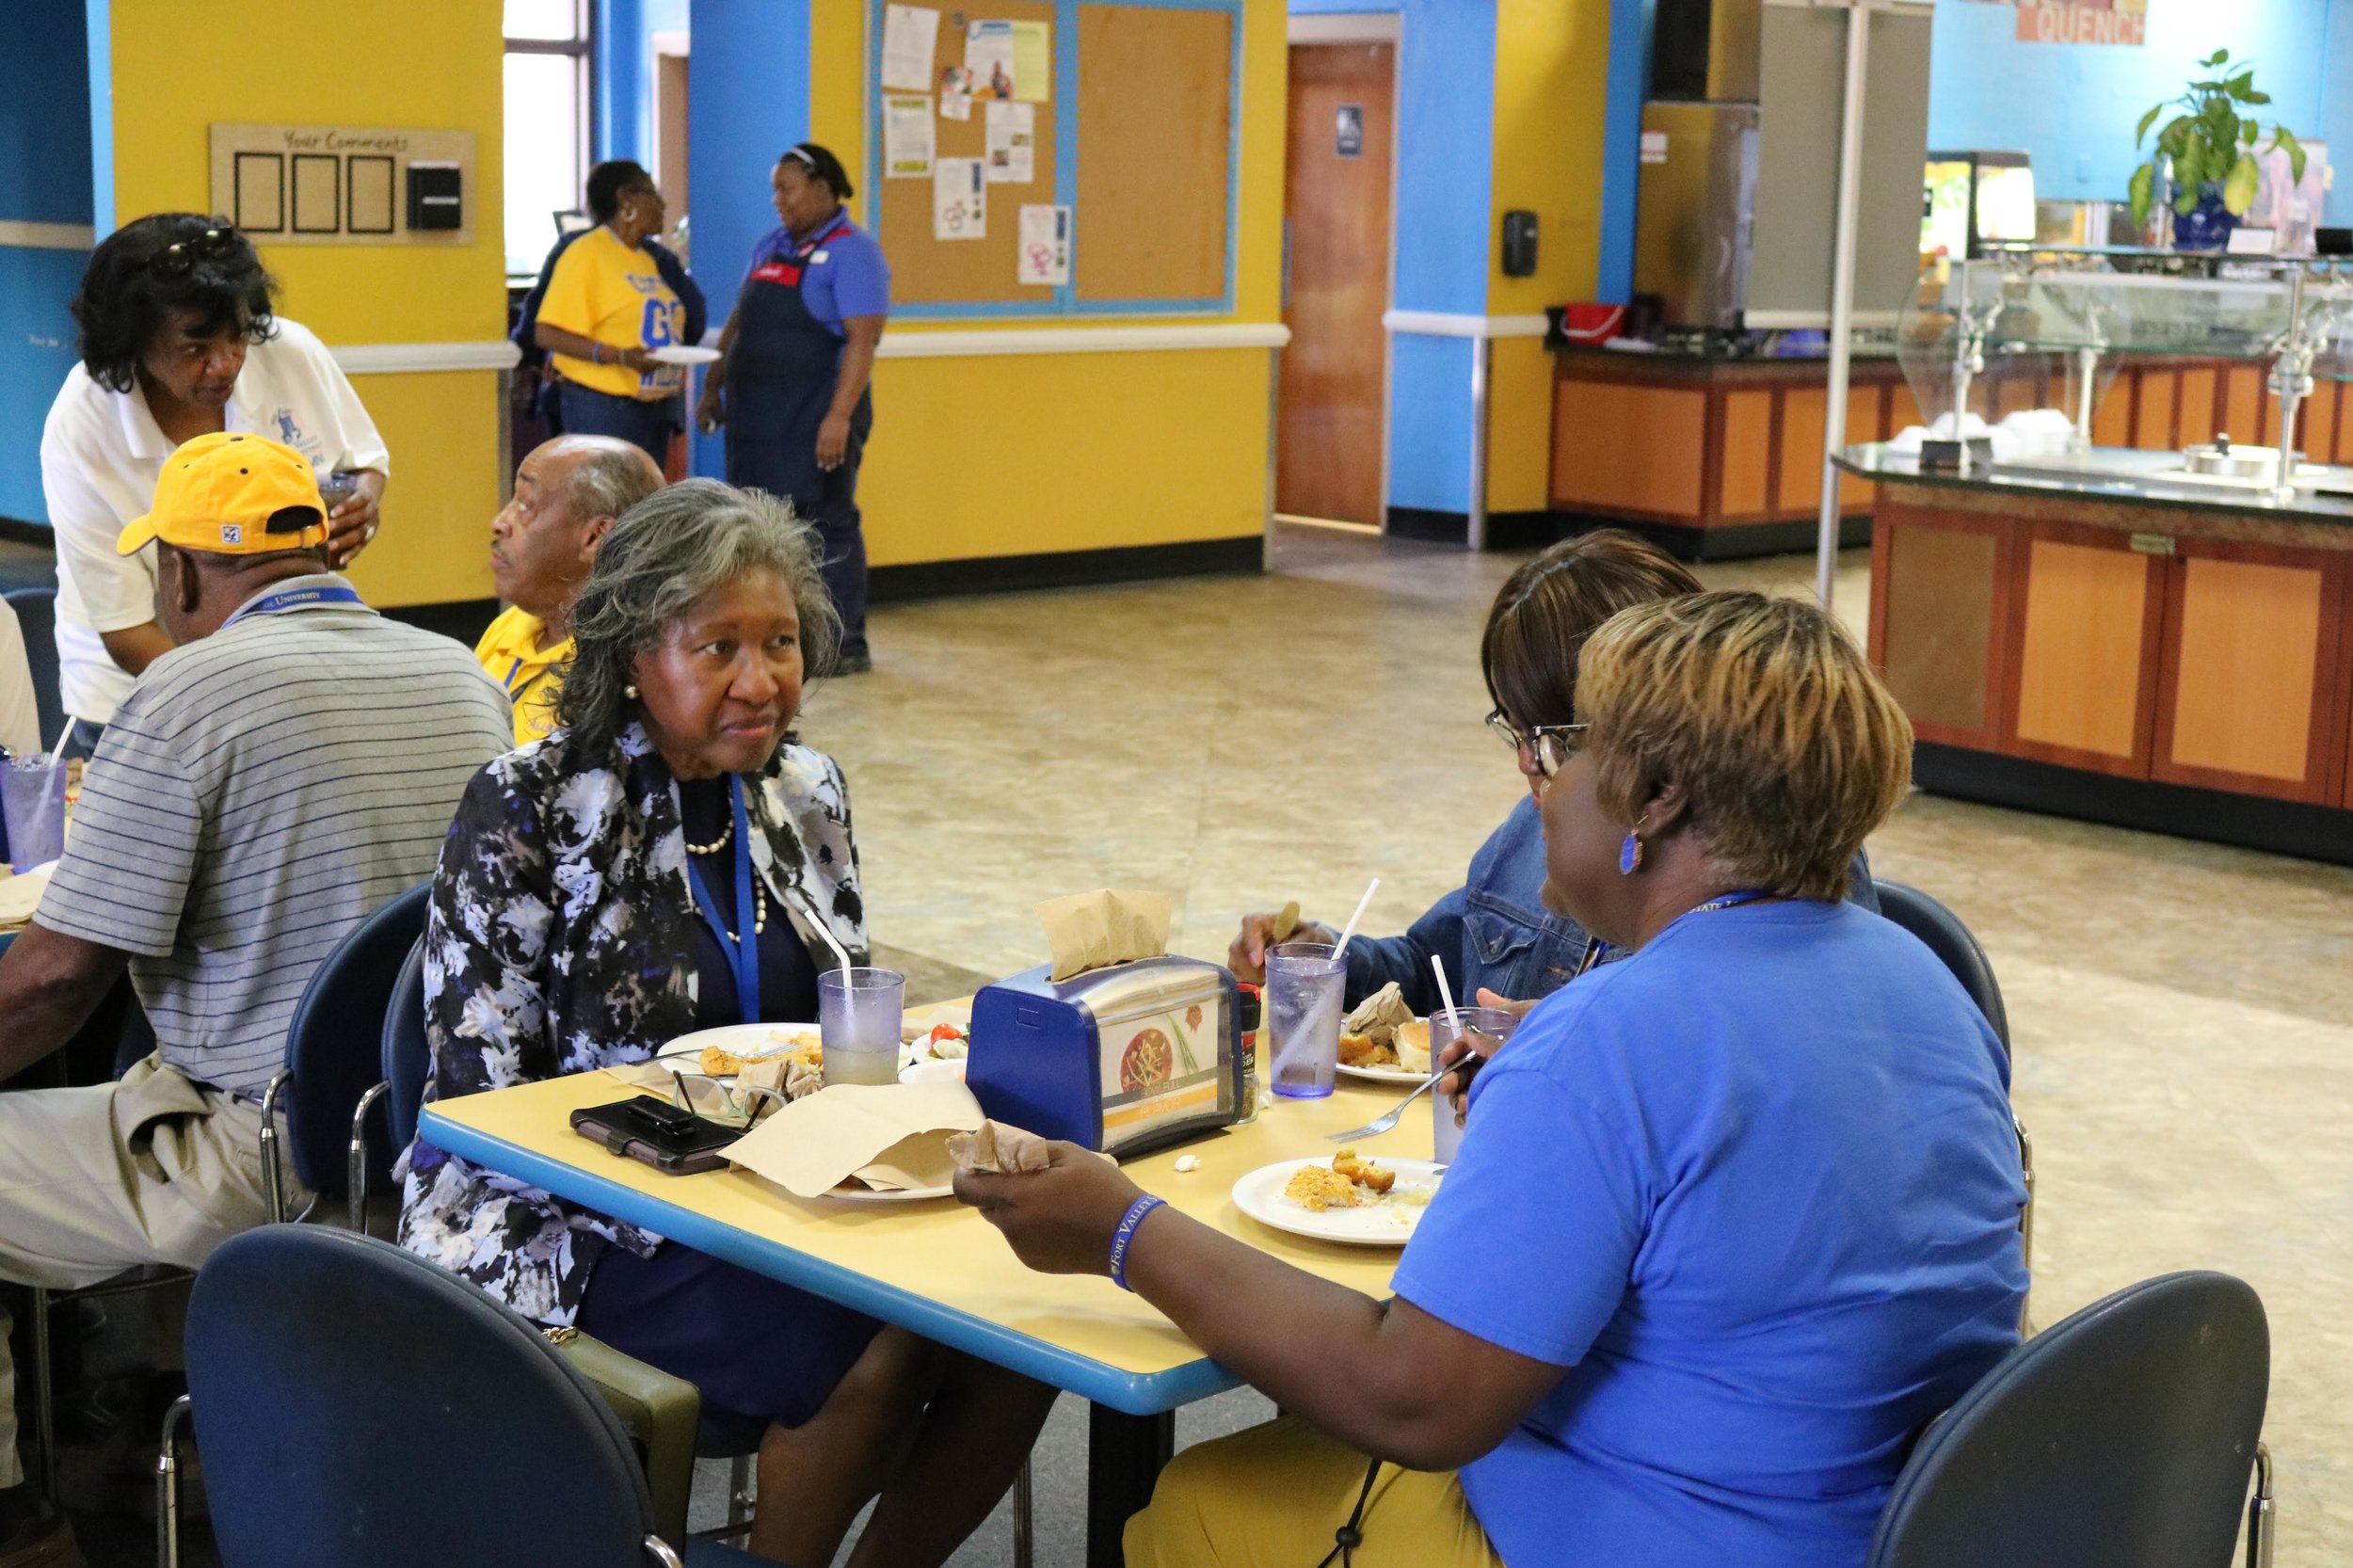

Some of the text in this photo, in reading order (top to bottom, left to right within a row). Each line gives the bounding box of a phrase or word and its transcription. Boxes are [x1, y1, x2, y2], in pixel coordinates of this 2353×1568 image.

[2037, 8, 2145, 44] QUENCH
[283, 129, 408, 152] Your Comments
[274, 591, 321, 606] UNIVERSITY
[1111, 1199, 1152, 1267] FORT VALLEY
